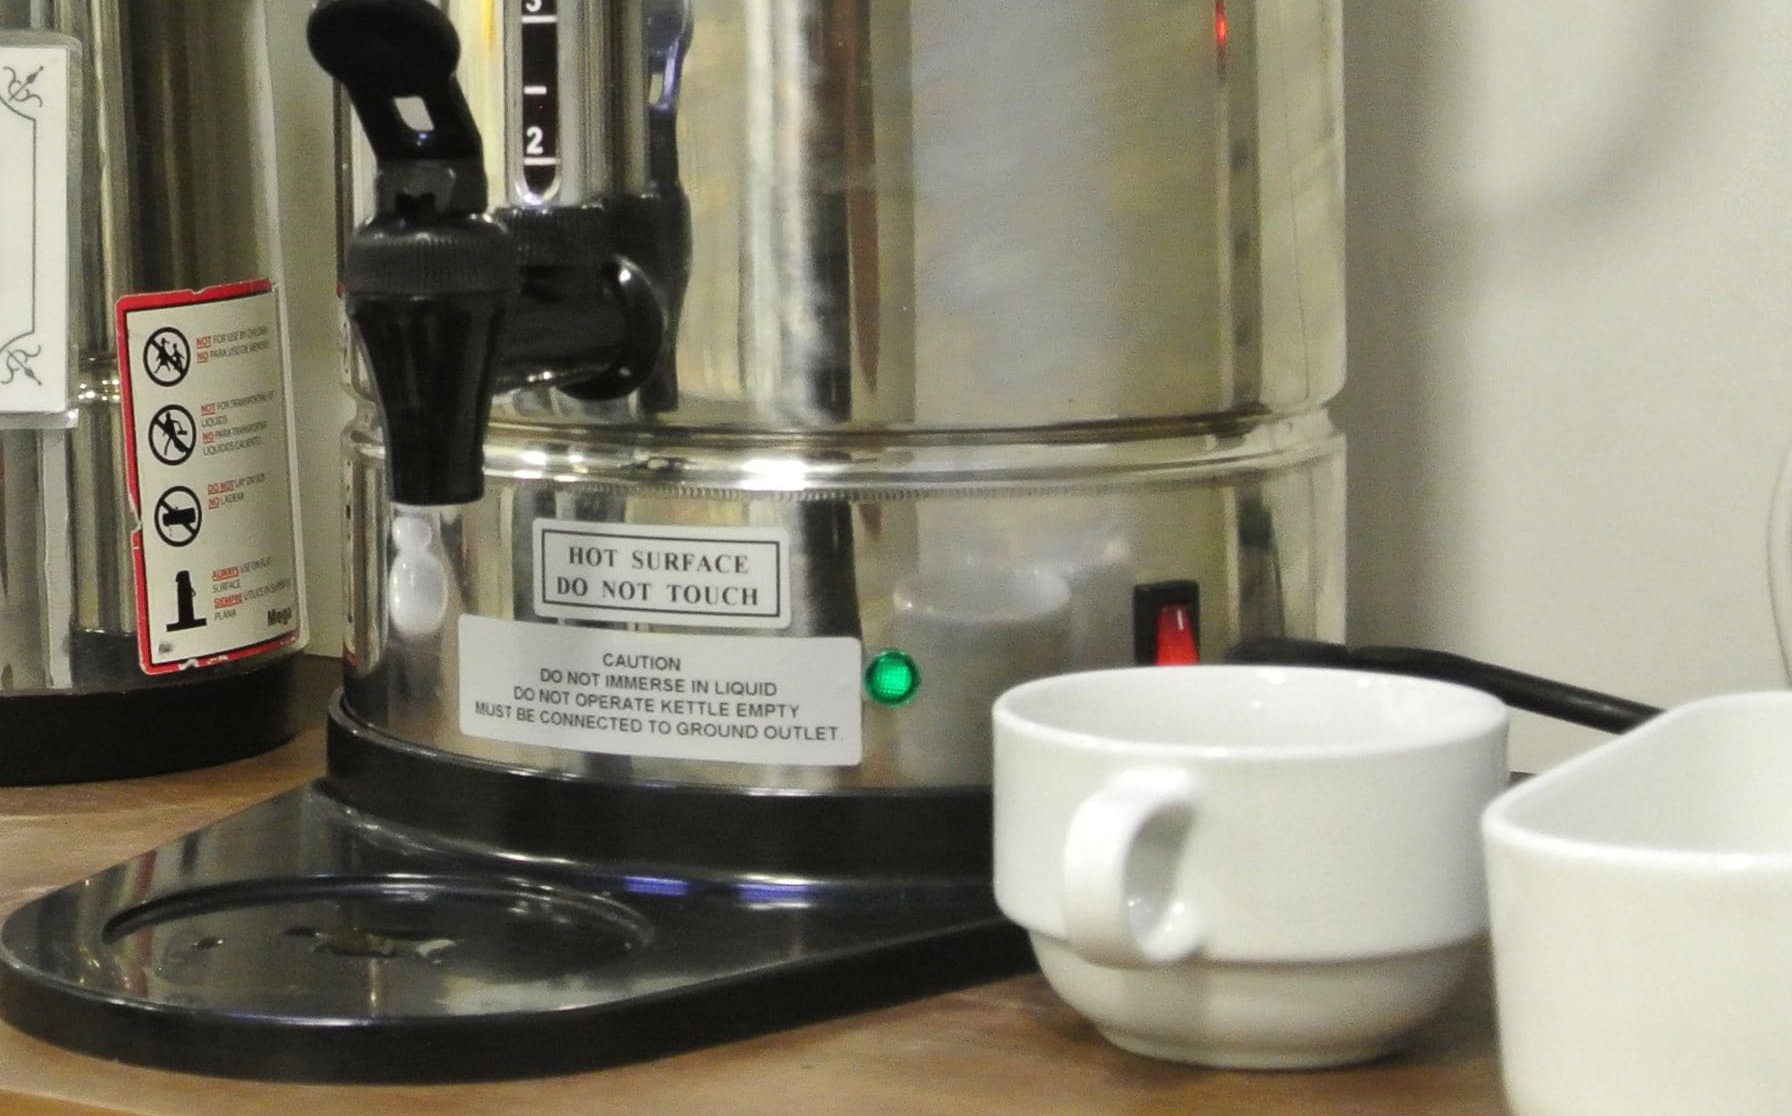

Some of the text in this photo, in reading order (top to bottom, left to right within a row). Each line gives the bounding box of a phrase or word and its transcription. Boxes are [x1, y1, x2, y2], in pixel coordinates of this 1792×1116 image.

[526, 126, 543, 155] 2
[568, 546, 750, 575] HOT SURFACE
[556, 576, 759, 607] DO NOT TOUCH
[603, 652, 681, 671] CAUTION
[540, 668, 777, 696] DO NOT IMMERSE IN LIQUID
[514, 686, 800, 719] DO NOT OPERATE KETTLE EMPTY
[475, 701, 512, 718] MUST
[516, 706, 536, 723] BE
[540, 710, 643, 734] CONNECTED
[648, 718, 672, 736] TO
[676, 721, 759, 740] GROUND
